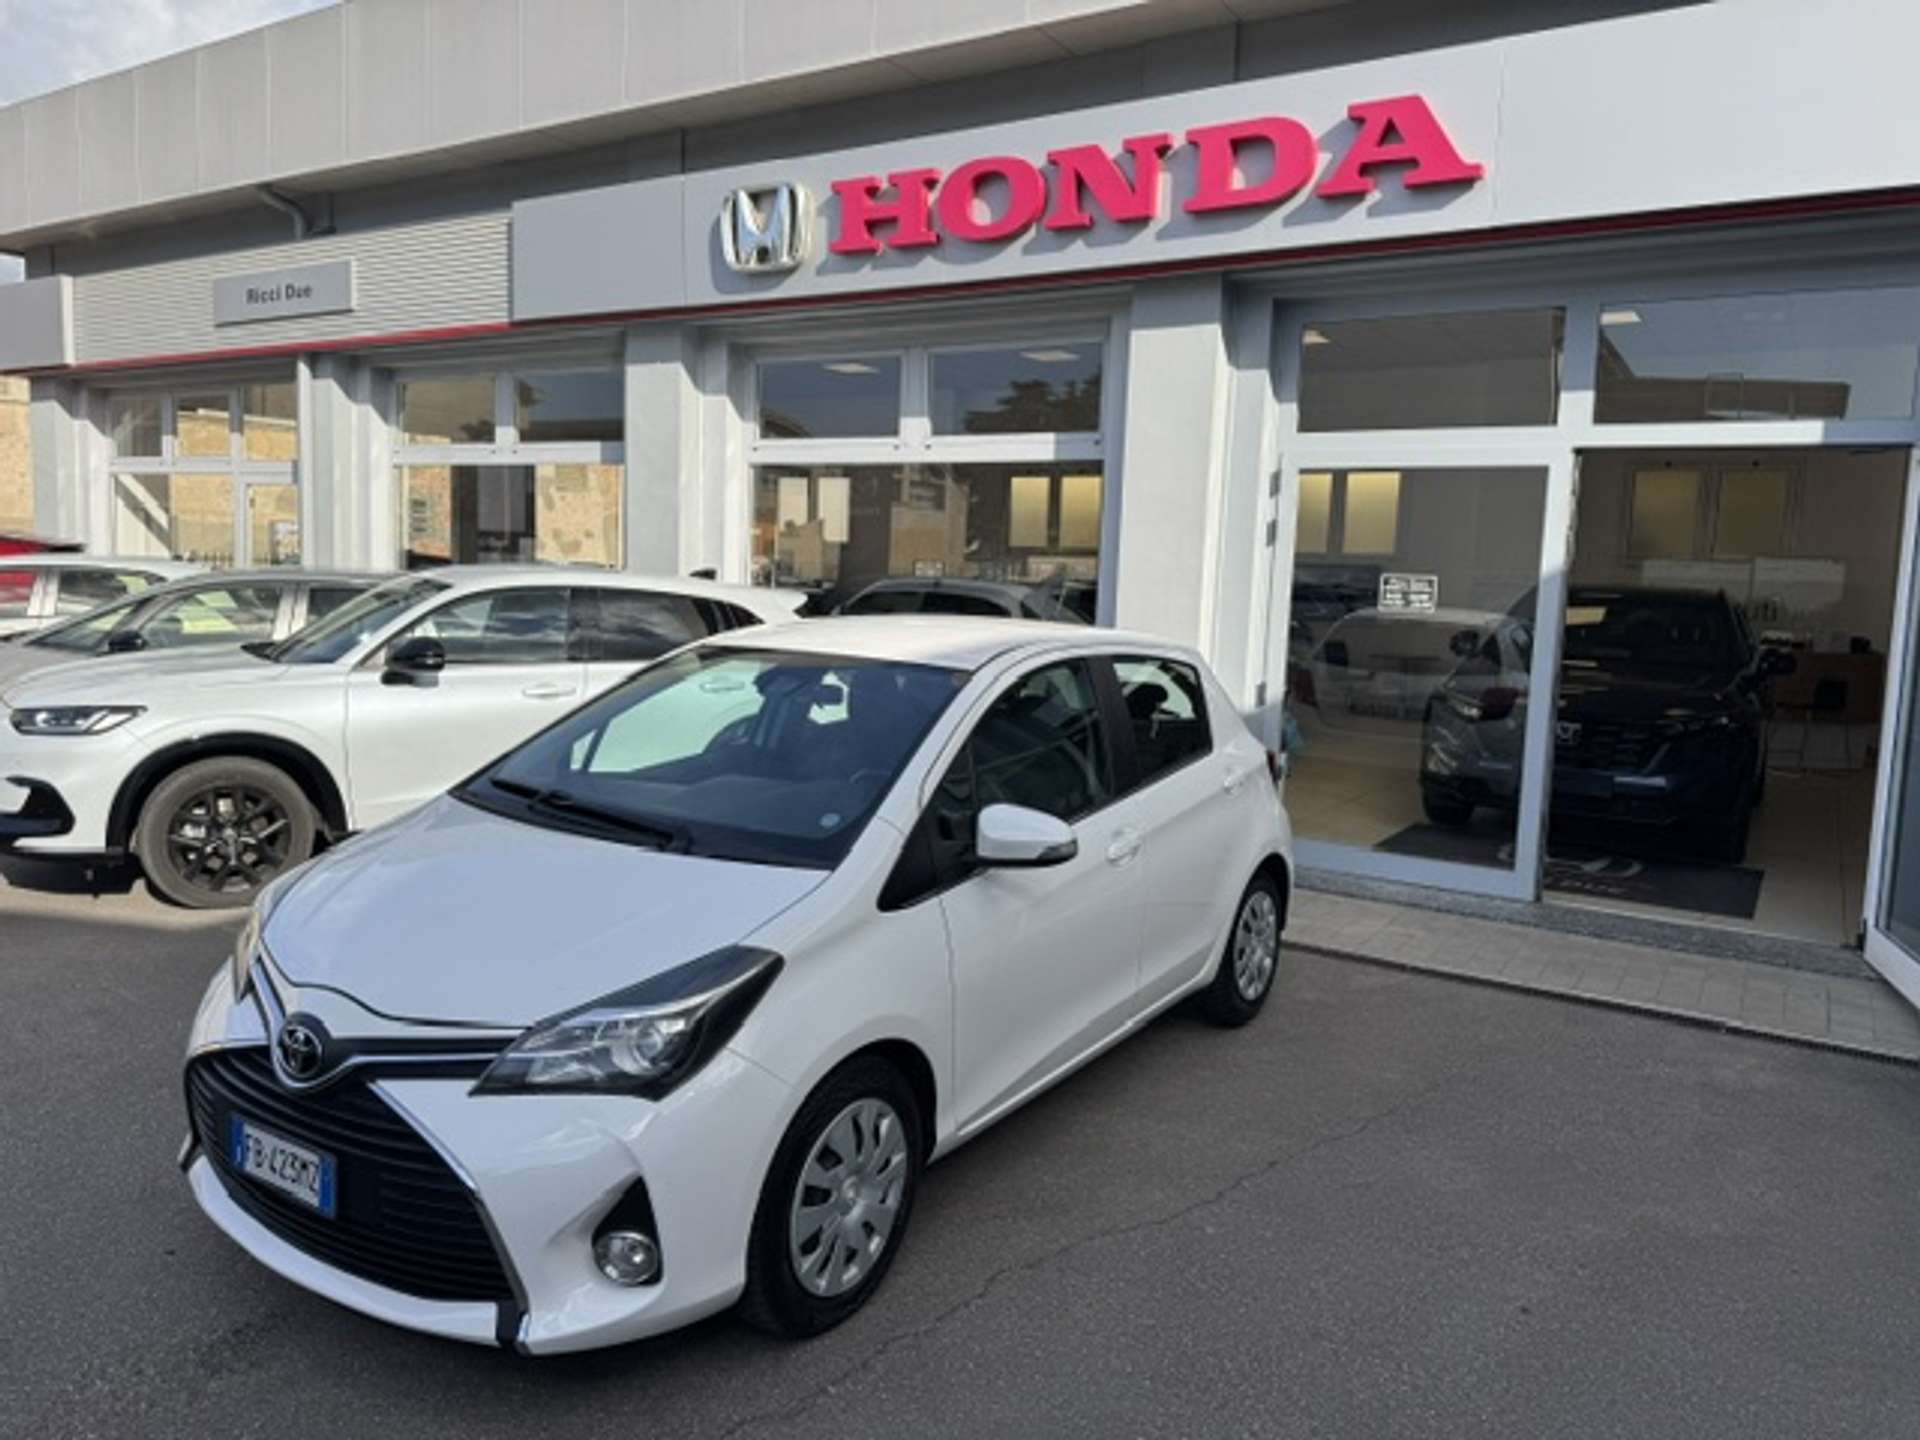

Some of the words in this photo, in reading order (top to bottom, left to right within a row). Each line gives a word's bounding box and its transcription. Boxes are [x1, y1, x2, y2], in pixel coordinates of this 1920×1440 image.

[829, 94, 1484, 254] HONDA
[246, 284, 281, 304] Ricci
[285, 283, 313, 300] Due
